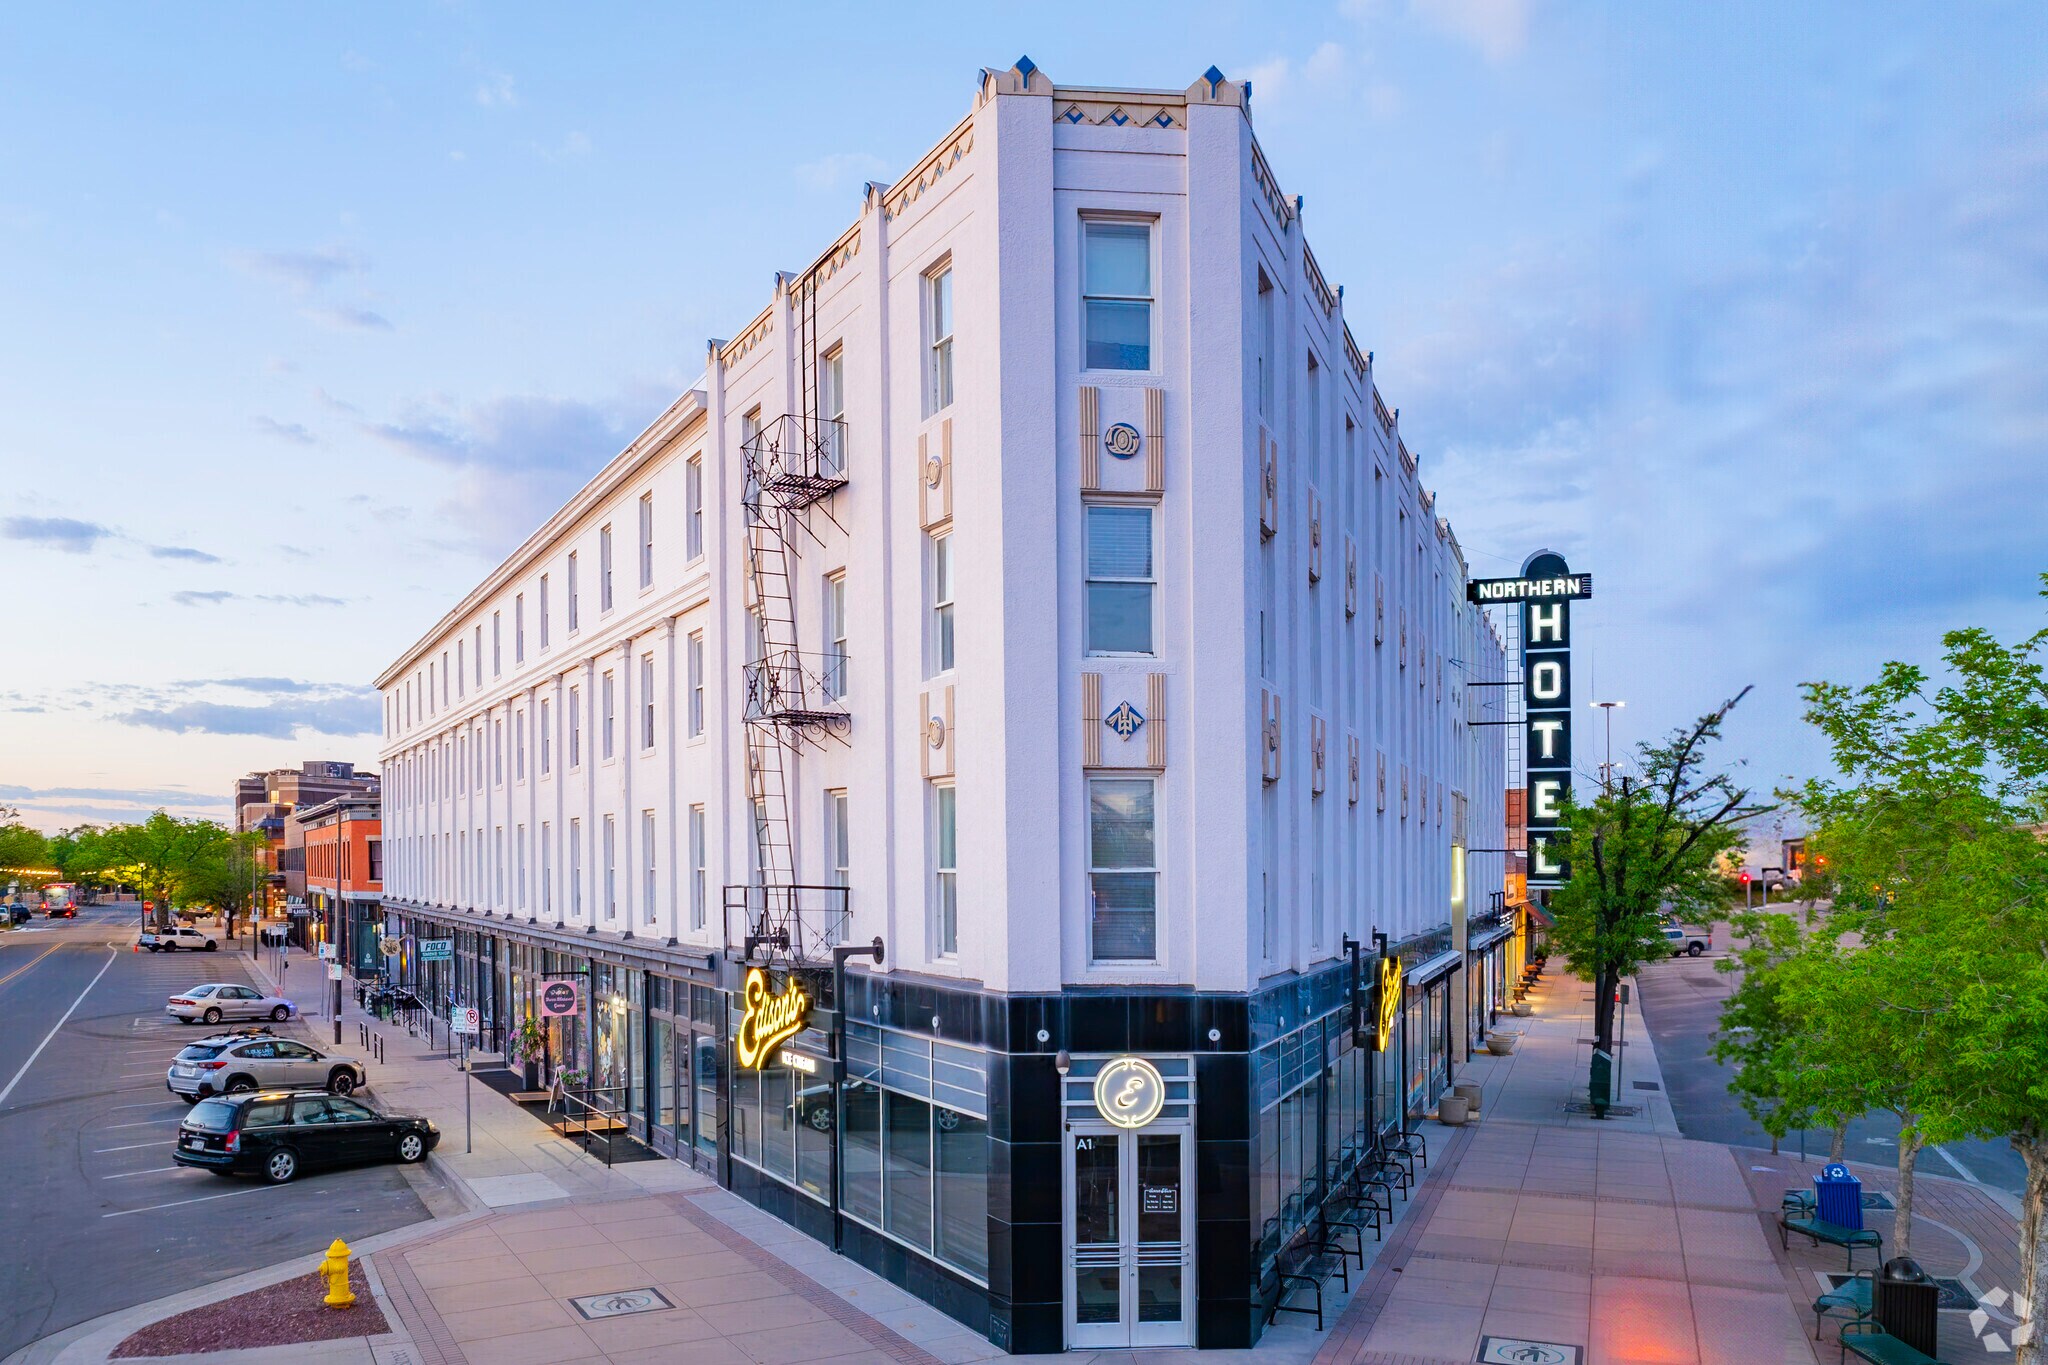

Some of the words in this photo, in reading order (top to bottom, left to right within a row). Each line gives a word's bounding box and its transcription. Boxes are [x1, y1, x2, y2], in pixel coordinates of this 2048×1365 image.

[1478, 578, 1580, 599] NORTHERN
[1530, 603, 1564, 875] HOTEL
[425, 942, 447, 951] FOCO
[739, 968, 805, 1068] Edison's
[781, 1051, 793, 1066] ICE
[793, 1053, 816, 1073] CREAM
[1116, 1077, 1144, 1108] E
[1076, 1138, 1092, 1150] A1
